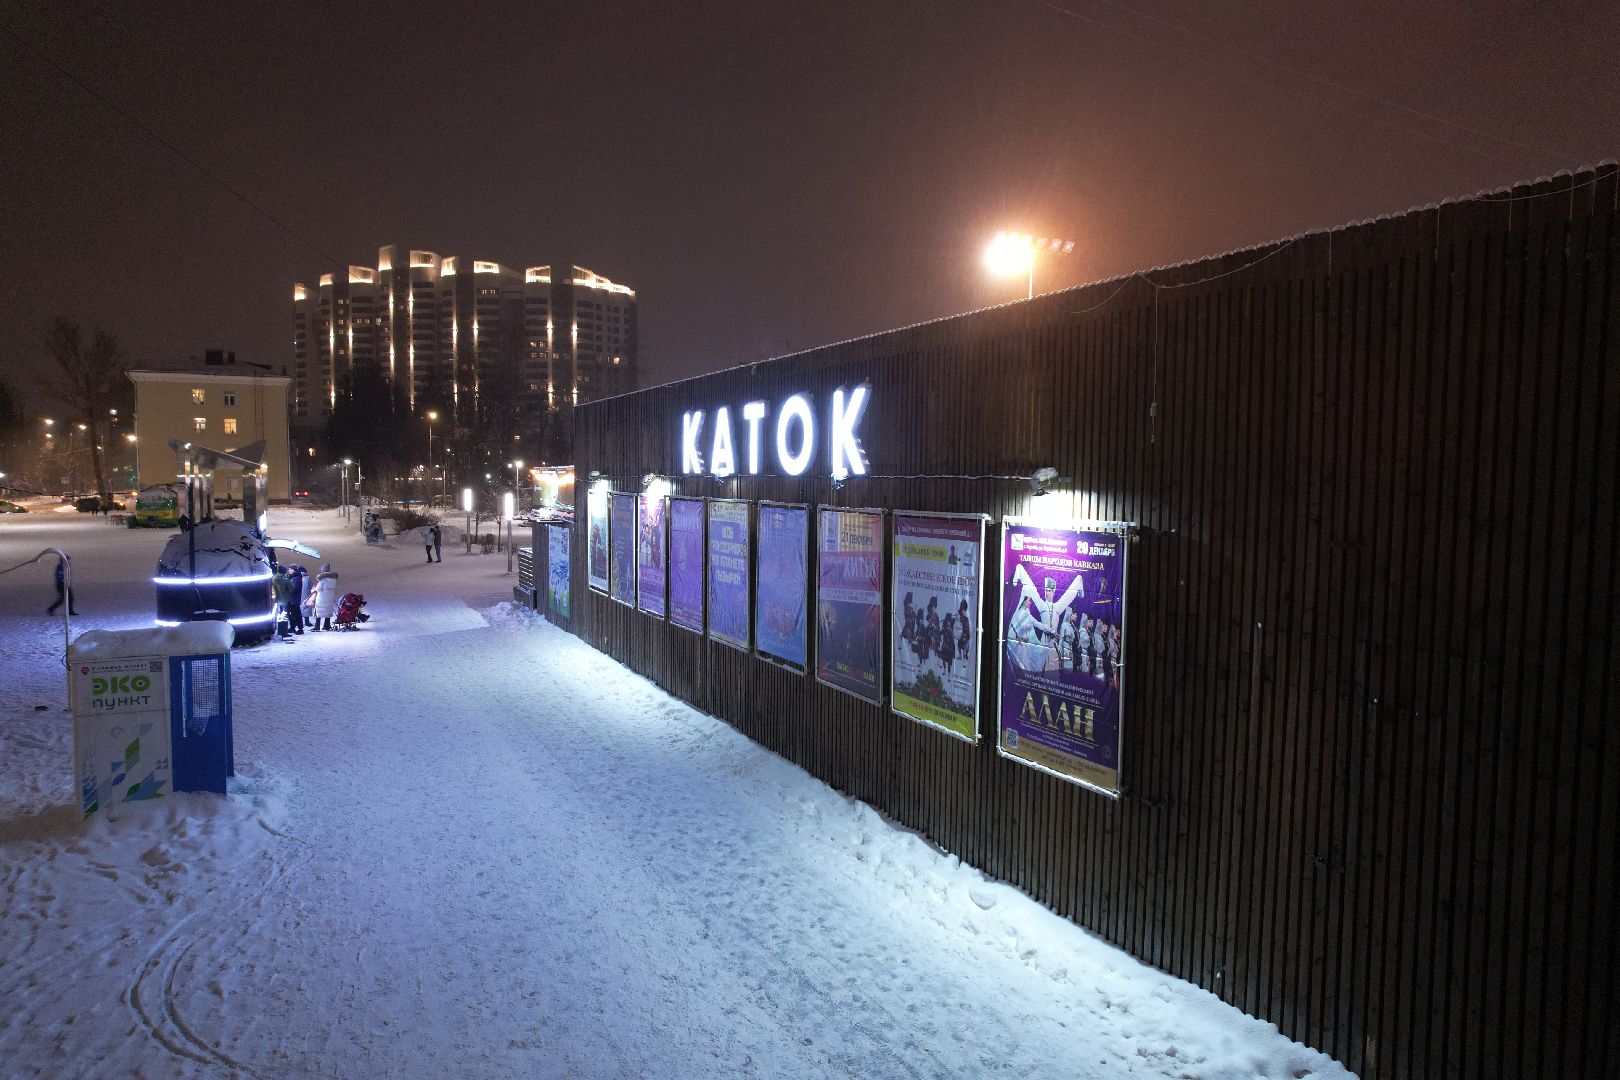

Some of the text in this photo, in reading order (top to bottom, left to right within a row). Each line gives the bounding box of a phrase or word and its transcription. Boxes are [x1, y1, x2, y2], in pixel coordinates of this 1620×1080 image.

[682, 386, 868, 476] КАТОК
[1076, 540, 1089, 555] 20
[1073, 560, 1105, 571] КАВКАЗА
[92, 675, 150, 696] ЭКО
[1017, 691, 1096, 741] АЛАН
